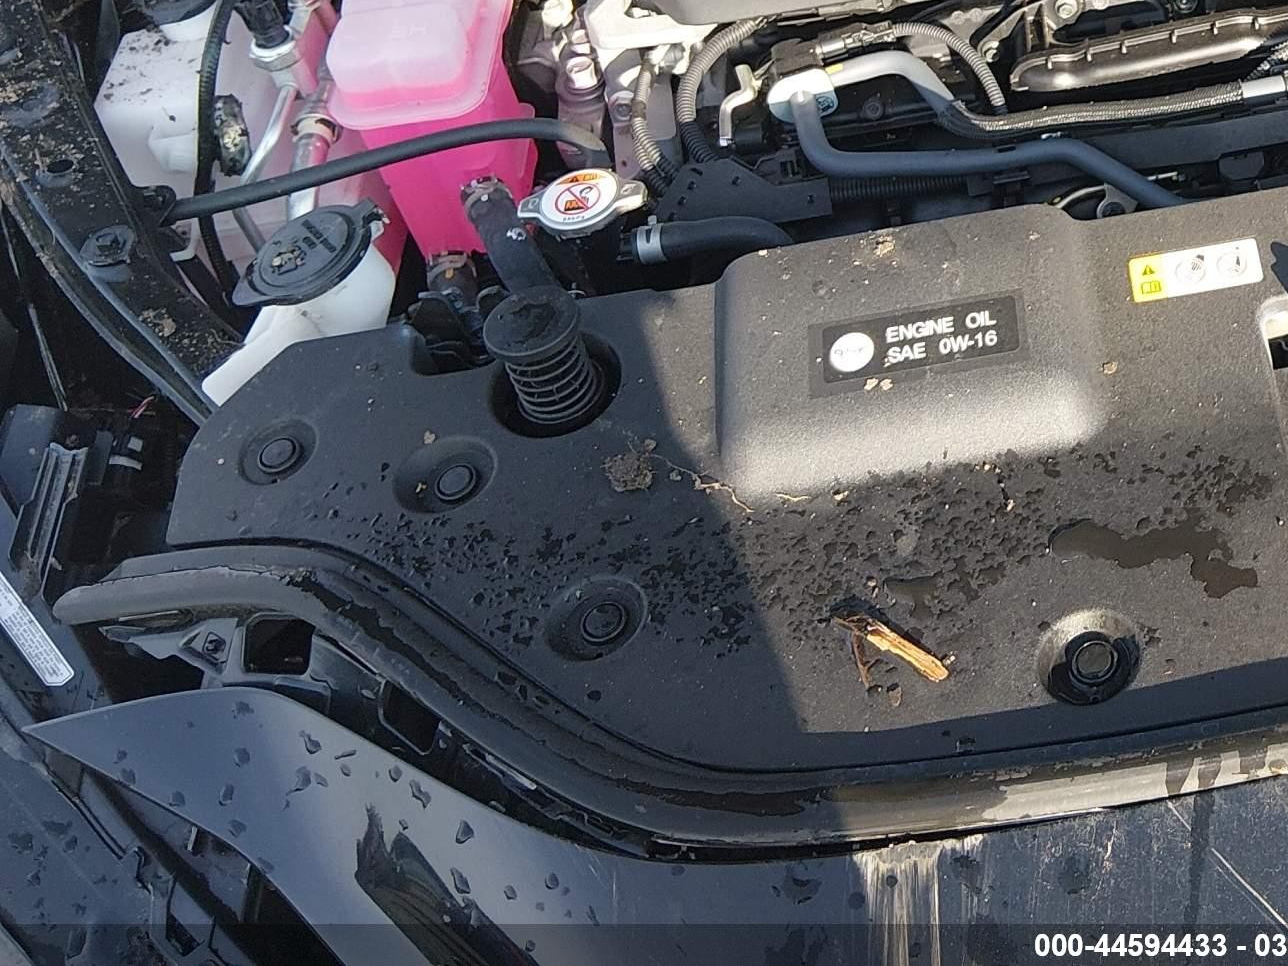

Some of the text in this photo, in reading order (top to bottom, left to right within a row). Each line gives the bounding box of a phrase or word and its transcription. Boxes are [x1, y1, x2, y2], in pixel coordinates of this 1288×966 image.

[885, 310, 997, 343] ENGINE OIL
[887, 342, 927, 364] SAE
[939, 329, 998, 356] 0W-16
